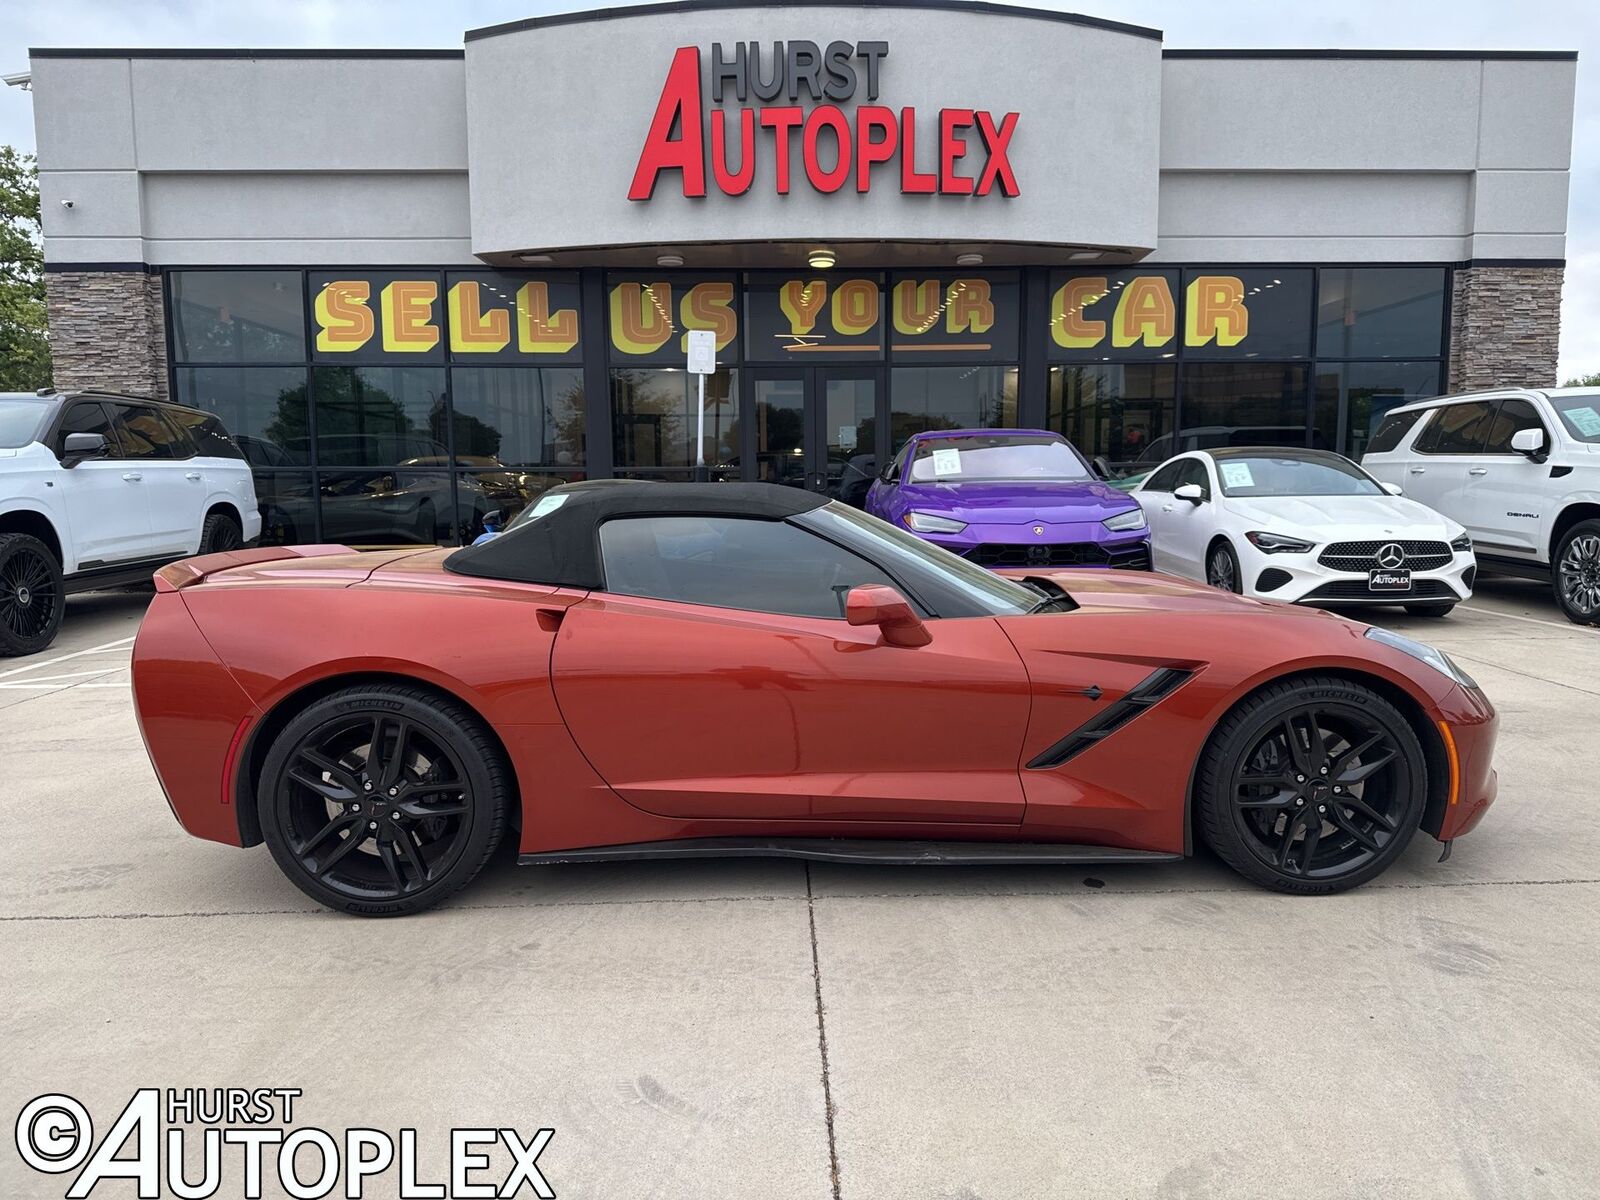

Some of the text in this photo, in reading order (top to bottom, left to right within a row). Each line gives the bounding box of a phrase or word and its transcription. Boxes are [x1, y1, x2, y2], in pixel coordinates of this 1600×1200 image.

[711, 40, 889, 101] HURST
[628, 46, 1021, 200] AUTOPLEX
[315, 280, 579, 353] SELL
[609, 281, 737, 354] US
[779, 279, 995, 336] YOUR
[1051, 276, 1249, 348] CAR
[1506, 511, 1539, 519] DENALI
[1371, 574, 1409, 584] AUTOPLEX
